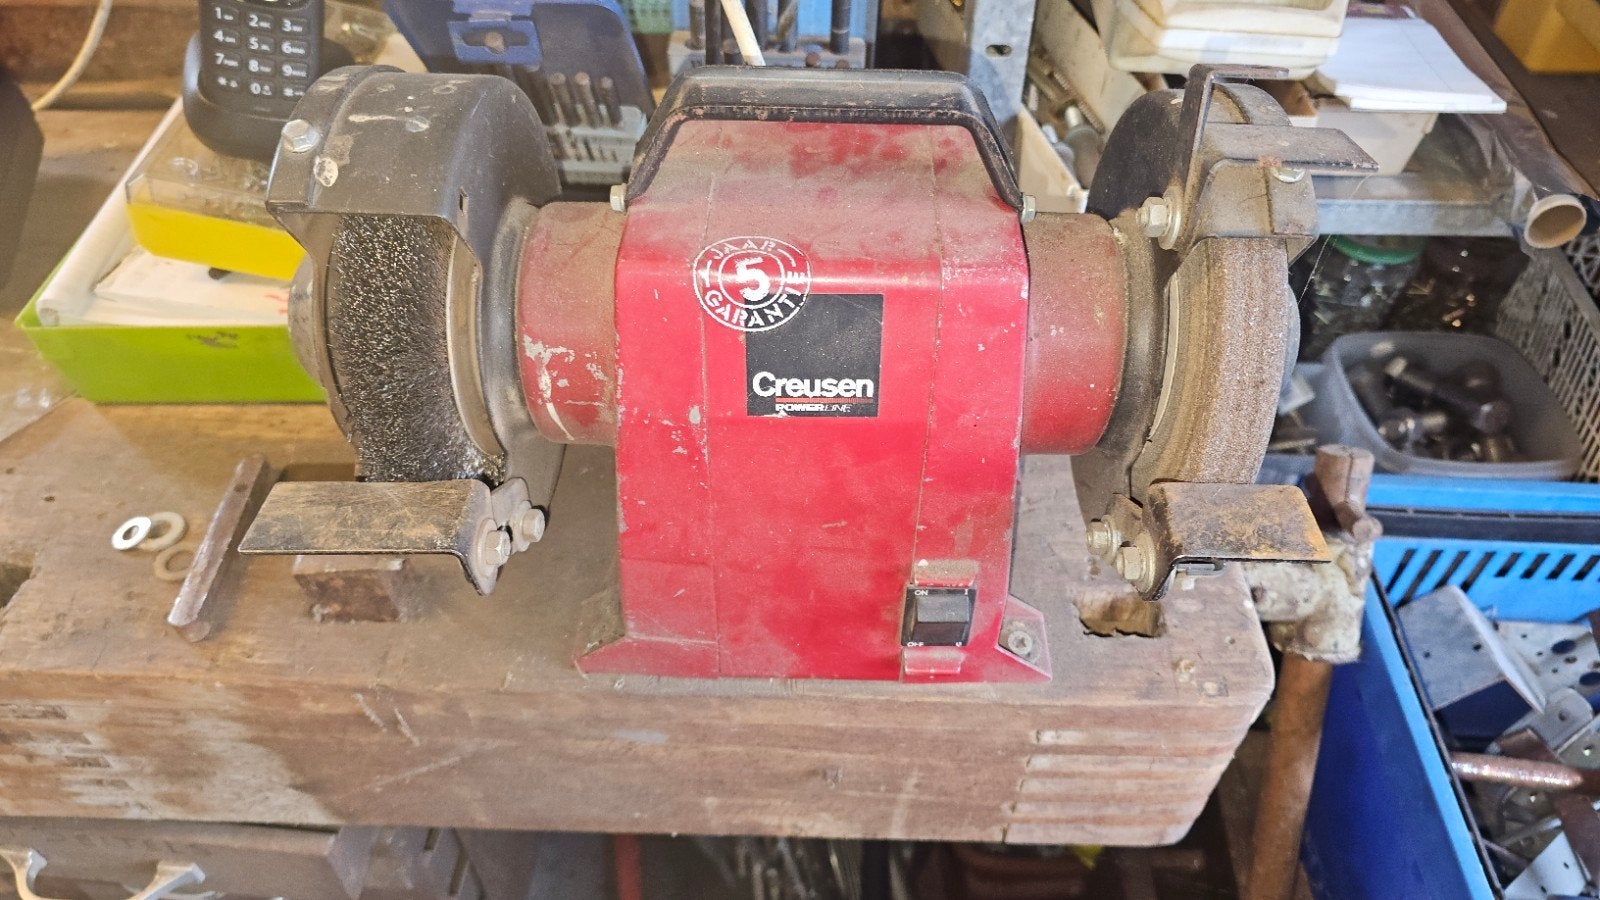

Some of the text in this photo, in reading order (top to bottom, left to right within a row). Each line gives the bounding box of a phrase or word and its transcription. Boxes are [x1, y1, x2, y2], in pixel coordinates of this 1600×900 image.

[214, 7, 222, 19] 1
[248, 14, 258, 27] 2
[282, 19, 292, 32] 3
[213, 30, 224, 42] 4
[248, 37, 259, 50] 5
[281, 42, 292, 54] 6
[214, 52, 224, 65] 7
[248, 59, 259, 72] 8
[282, 64, 293, 77] 9
[250, 82, 261, 95] 0
[710, 239, 776, 260] JAAR
[735, 257, 770, 301] 5
[704, 271, 805, 327] GARANTIE
[752, 371, 874, 398] Creusen
